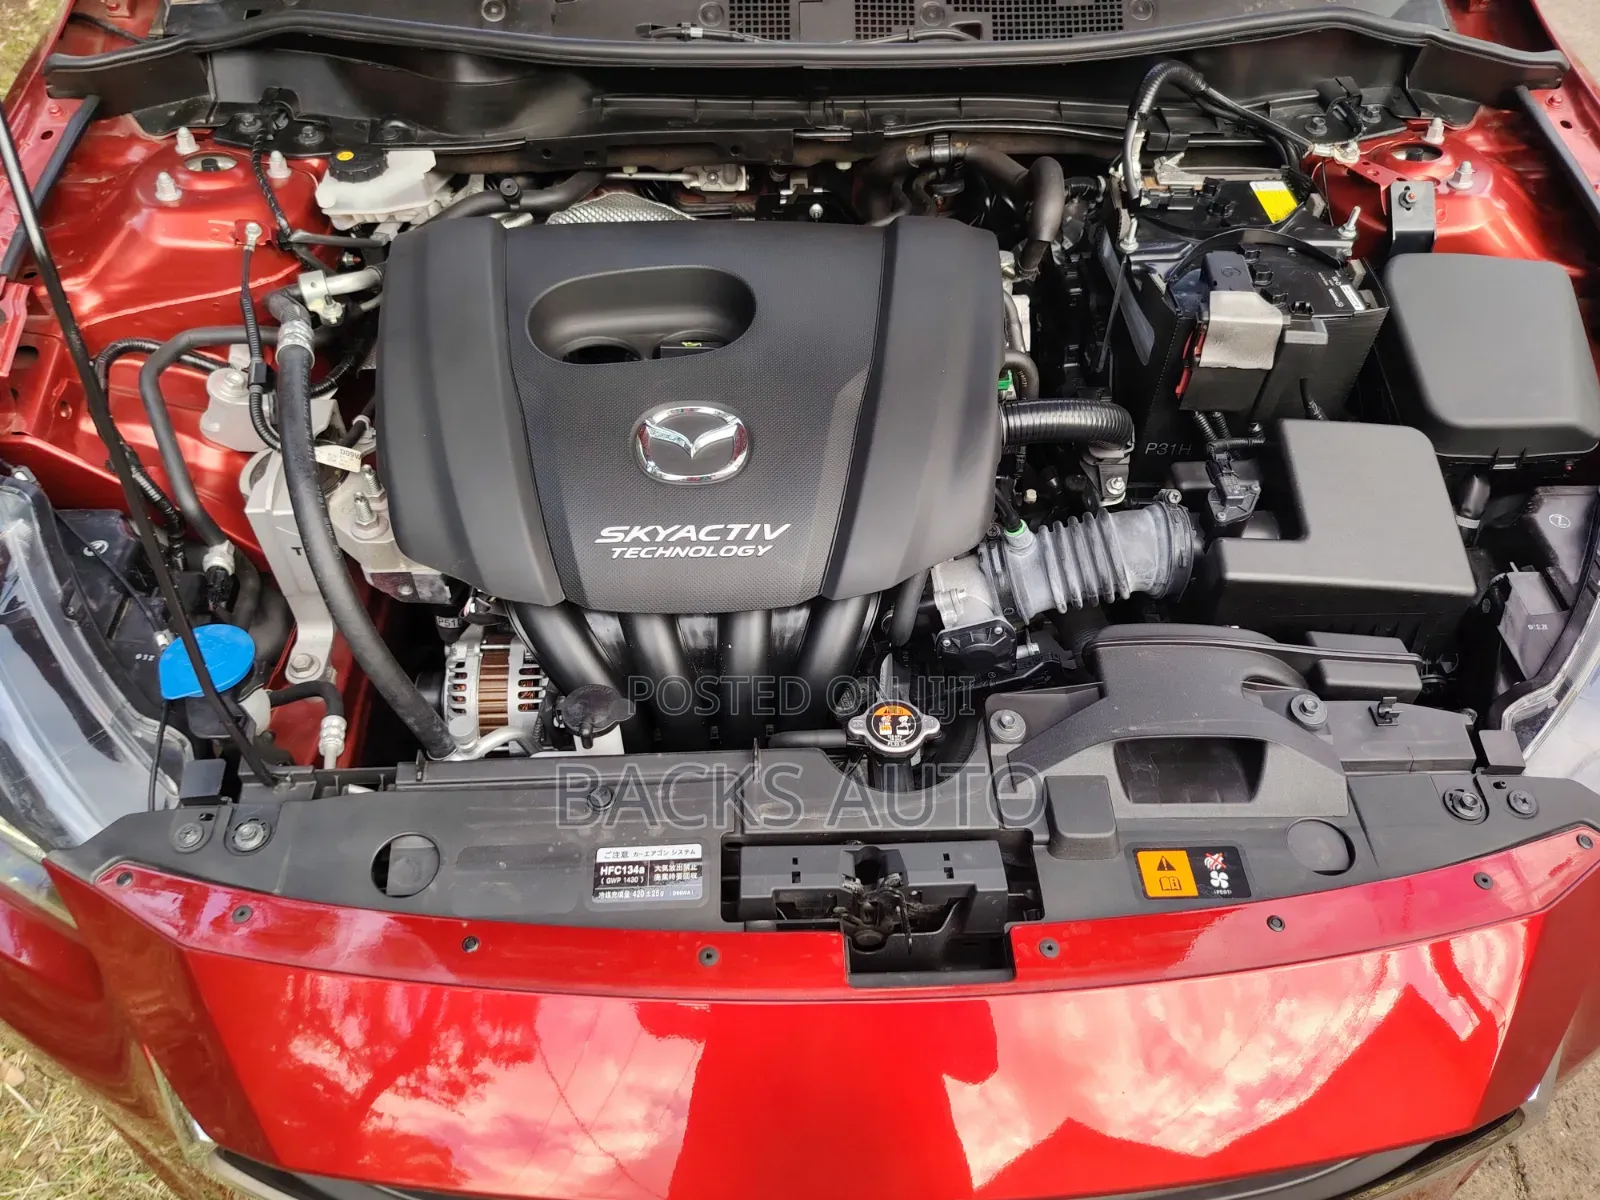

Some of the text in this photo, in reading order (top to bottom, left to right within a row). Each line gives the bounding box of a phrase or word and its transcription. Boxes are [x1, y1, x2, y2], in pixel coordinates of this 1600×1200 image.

[1145, 442, 1192, 456] P31H
[594, 523, 792, 544] SKYACTIV
[611, 545, 774, 559] TECHNOLOGY
[600, 865, 645, 876] HFC134a
